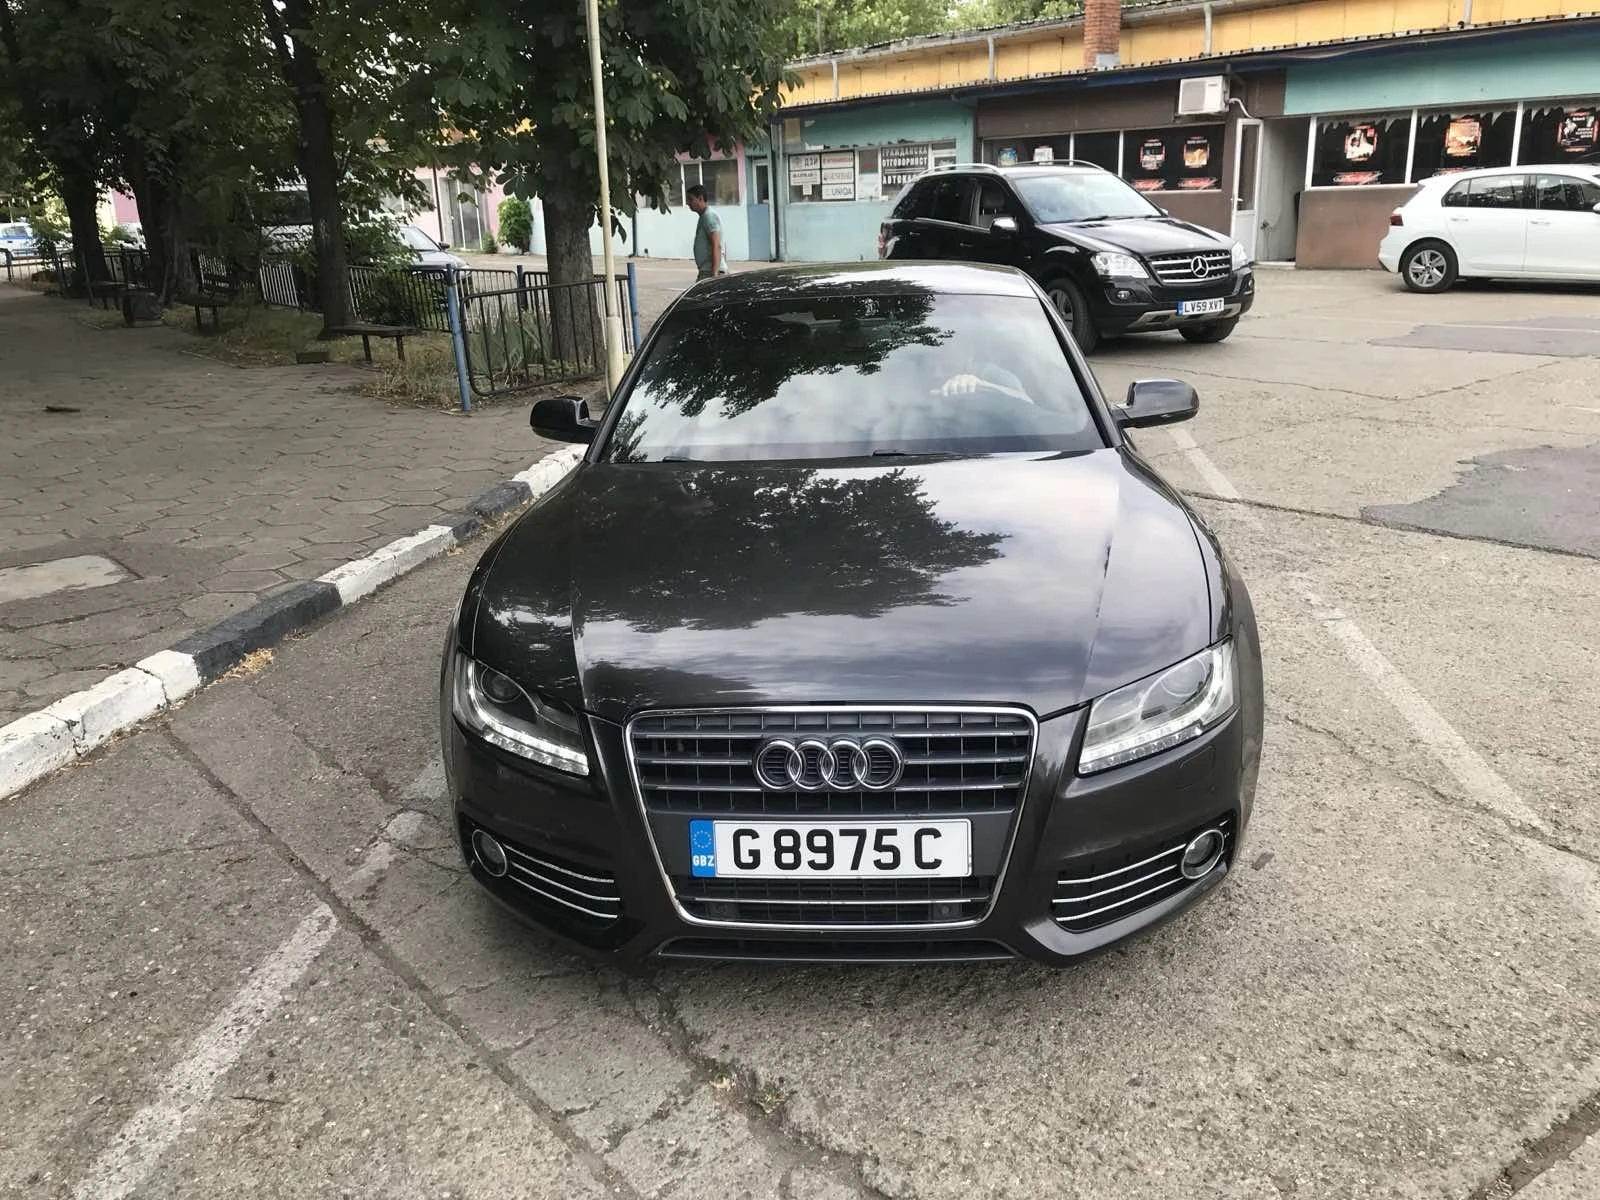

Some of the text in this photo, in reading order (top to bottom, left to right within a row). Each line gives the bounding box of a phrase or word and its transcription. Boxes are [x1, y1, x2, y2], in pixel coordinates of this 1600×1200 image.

[1185, 299, 1223, 313] LV59 XVT
[732, 827, 943, 871] G 8975 C
[692, 855, 714, 867] GBZ
